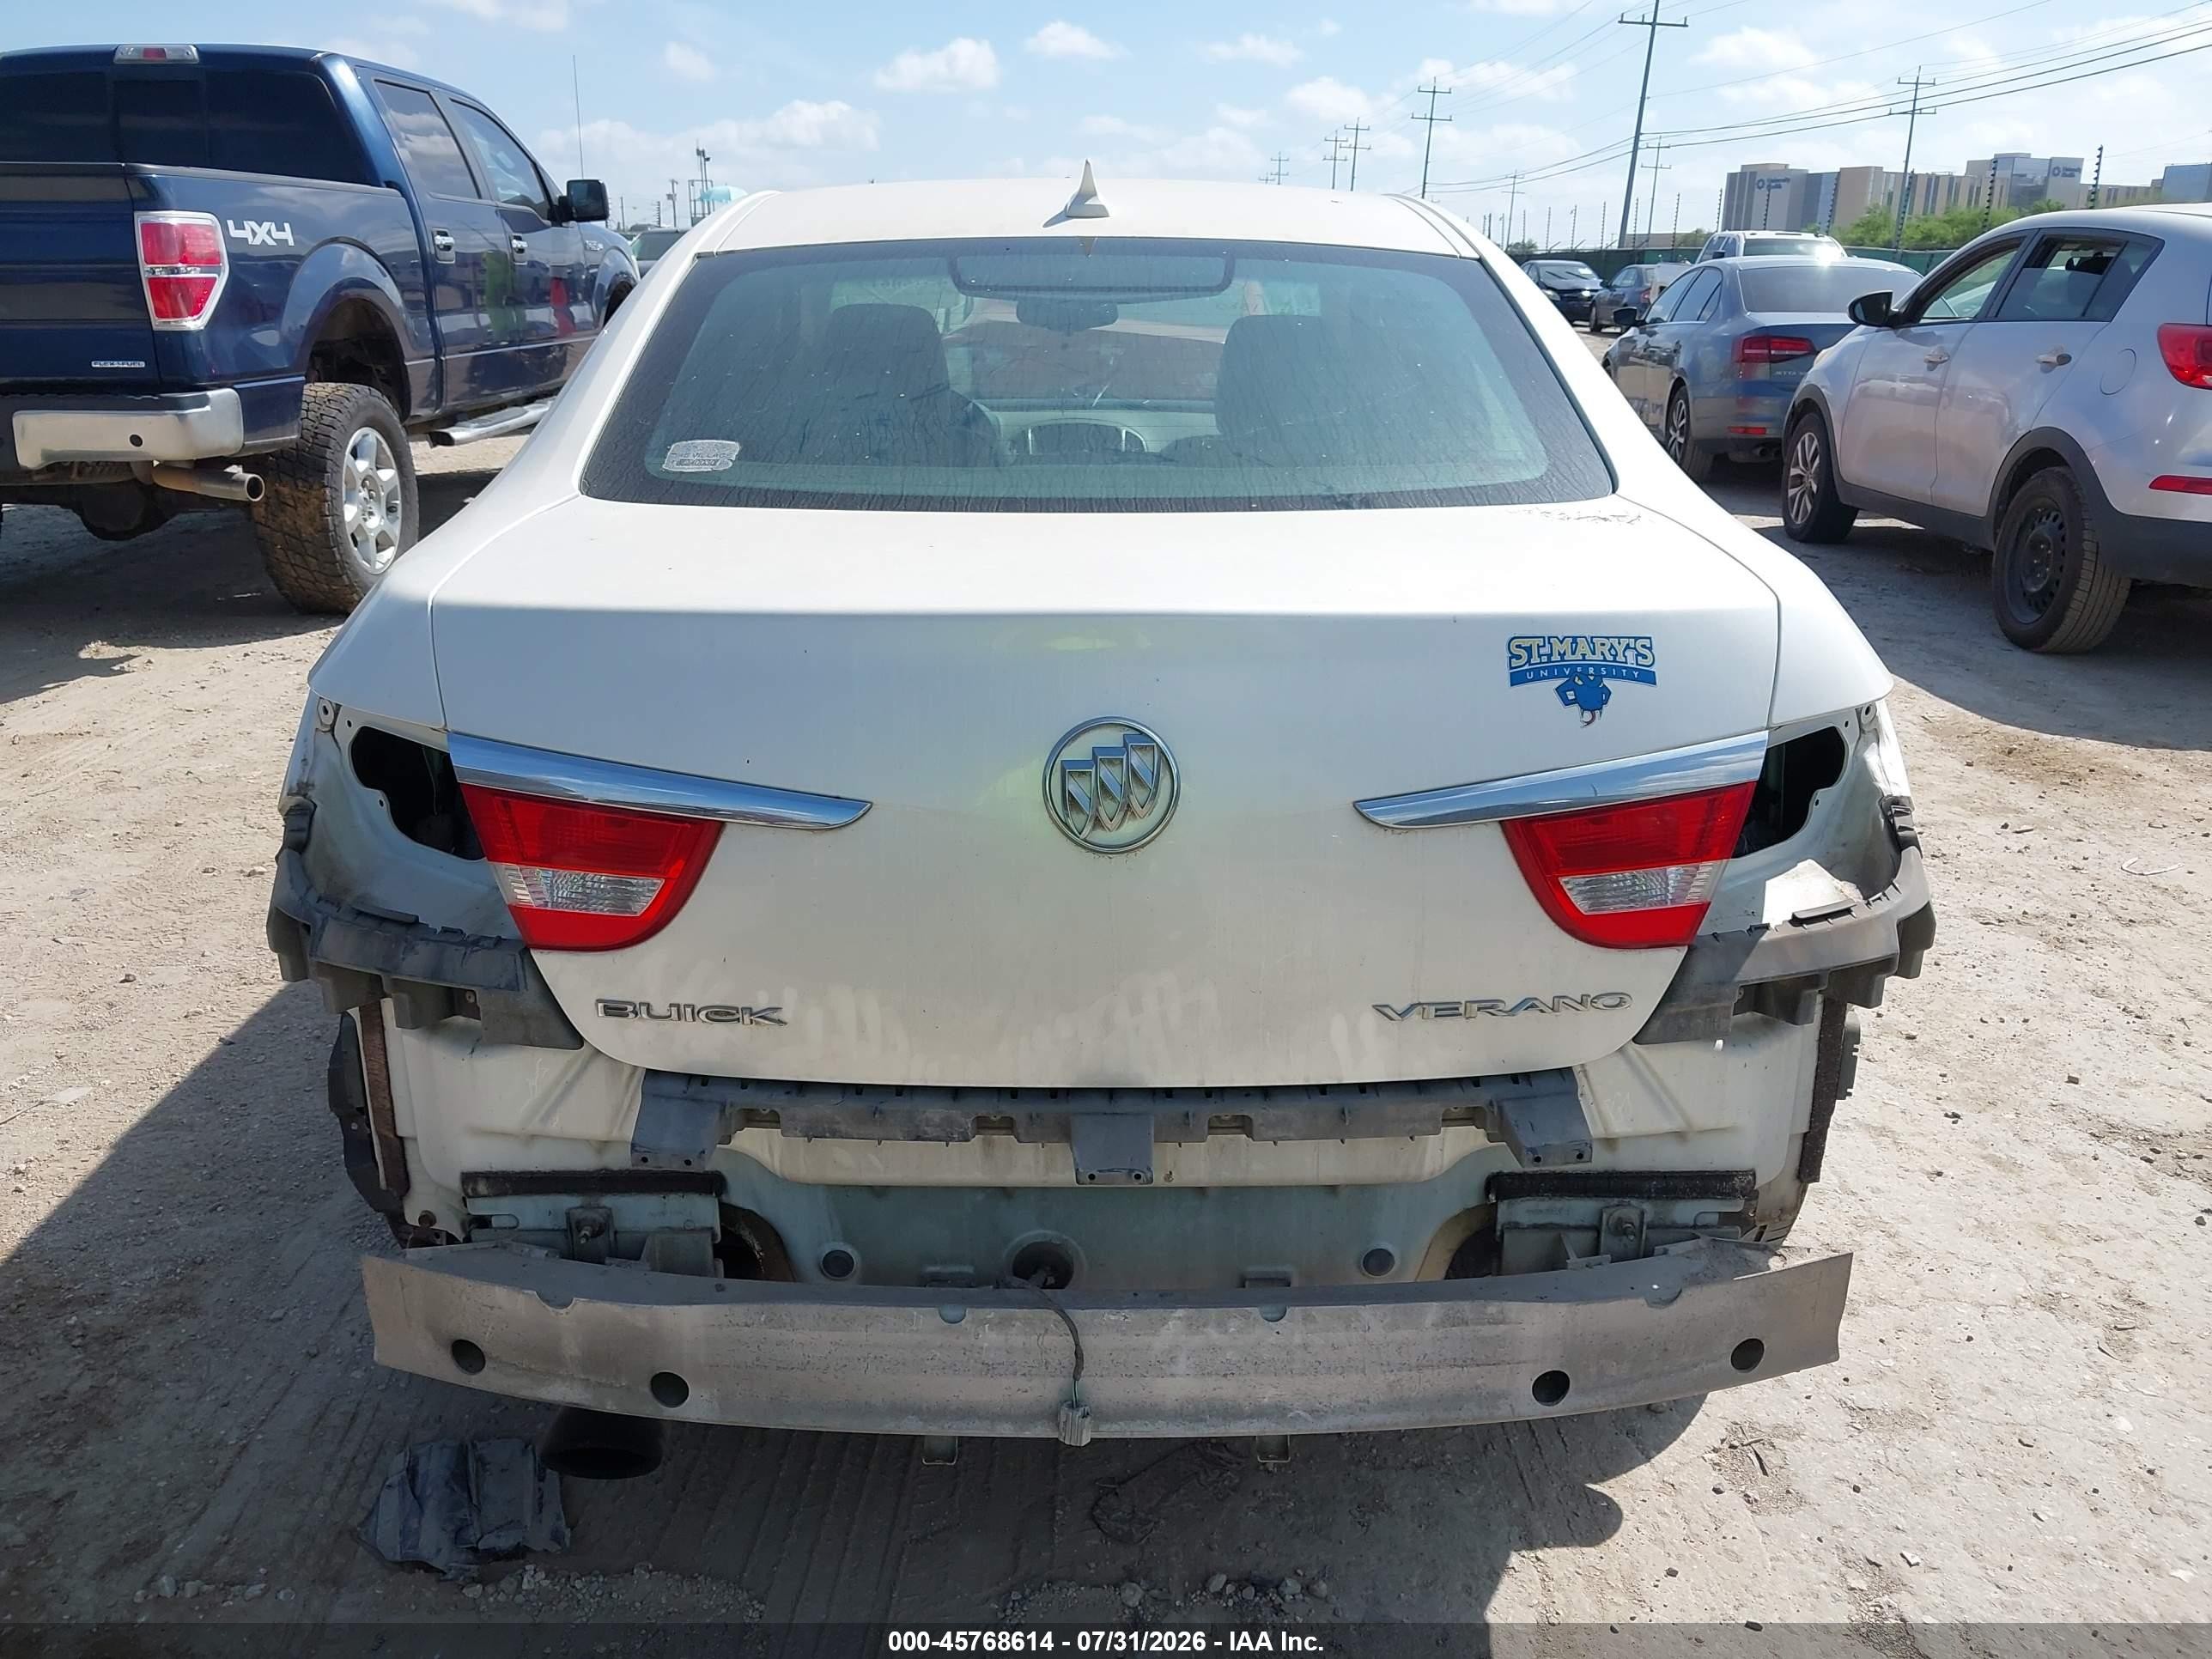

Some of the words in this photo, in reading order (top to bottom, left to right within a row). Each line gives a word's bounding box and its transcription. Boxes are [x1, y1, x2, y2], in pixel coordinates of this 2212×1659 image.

[226, 219, 295, 246] 4X4
[1526, 666, 1640, 680] UNIVERSITY
[595, 998, 787, 1026] BUICK
[1371, 992, 1633, 1021] VERANO
